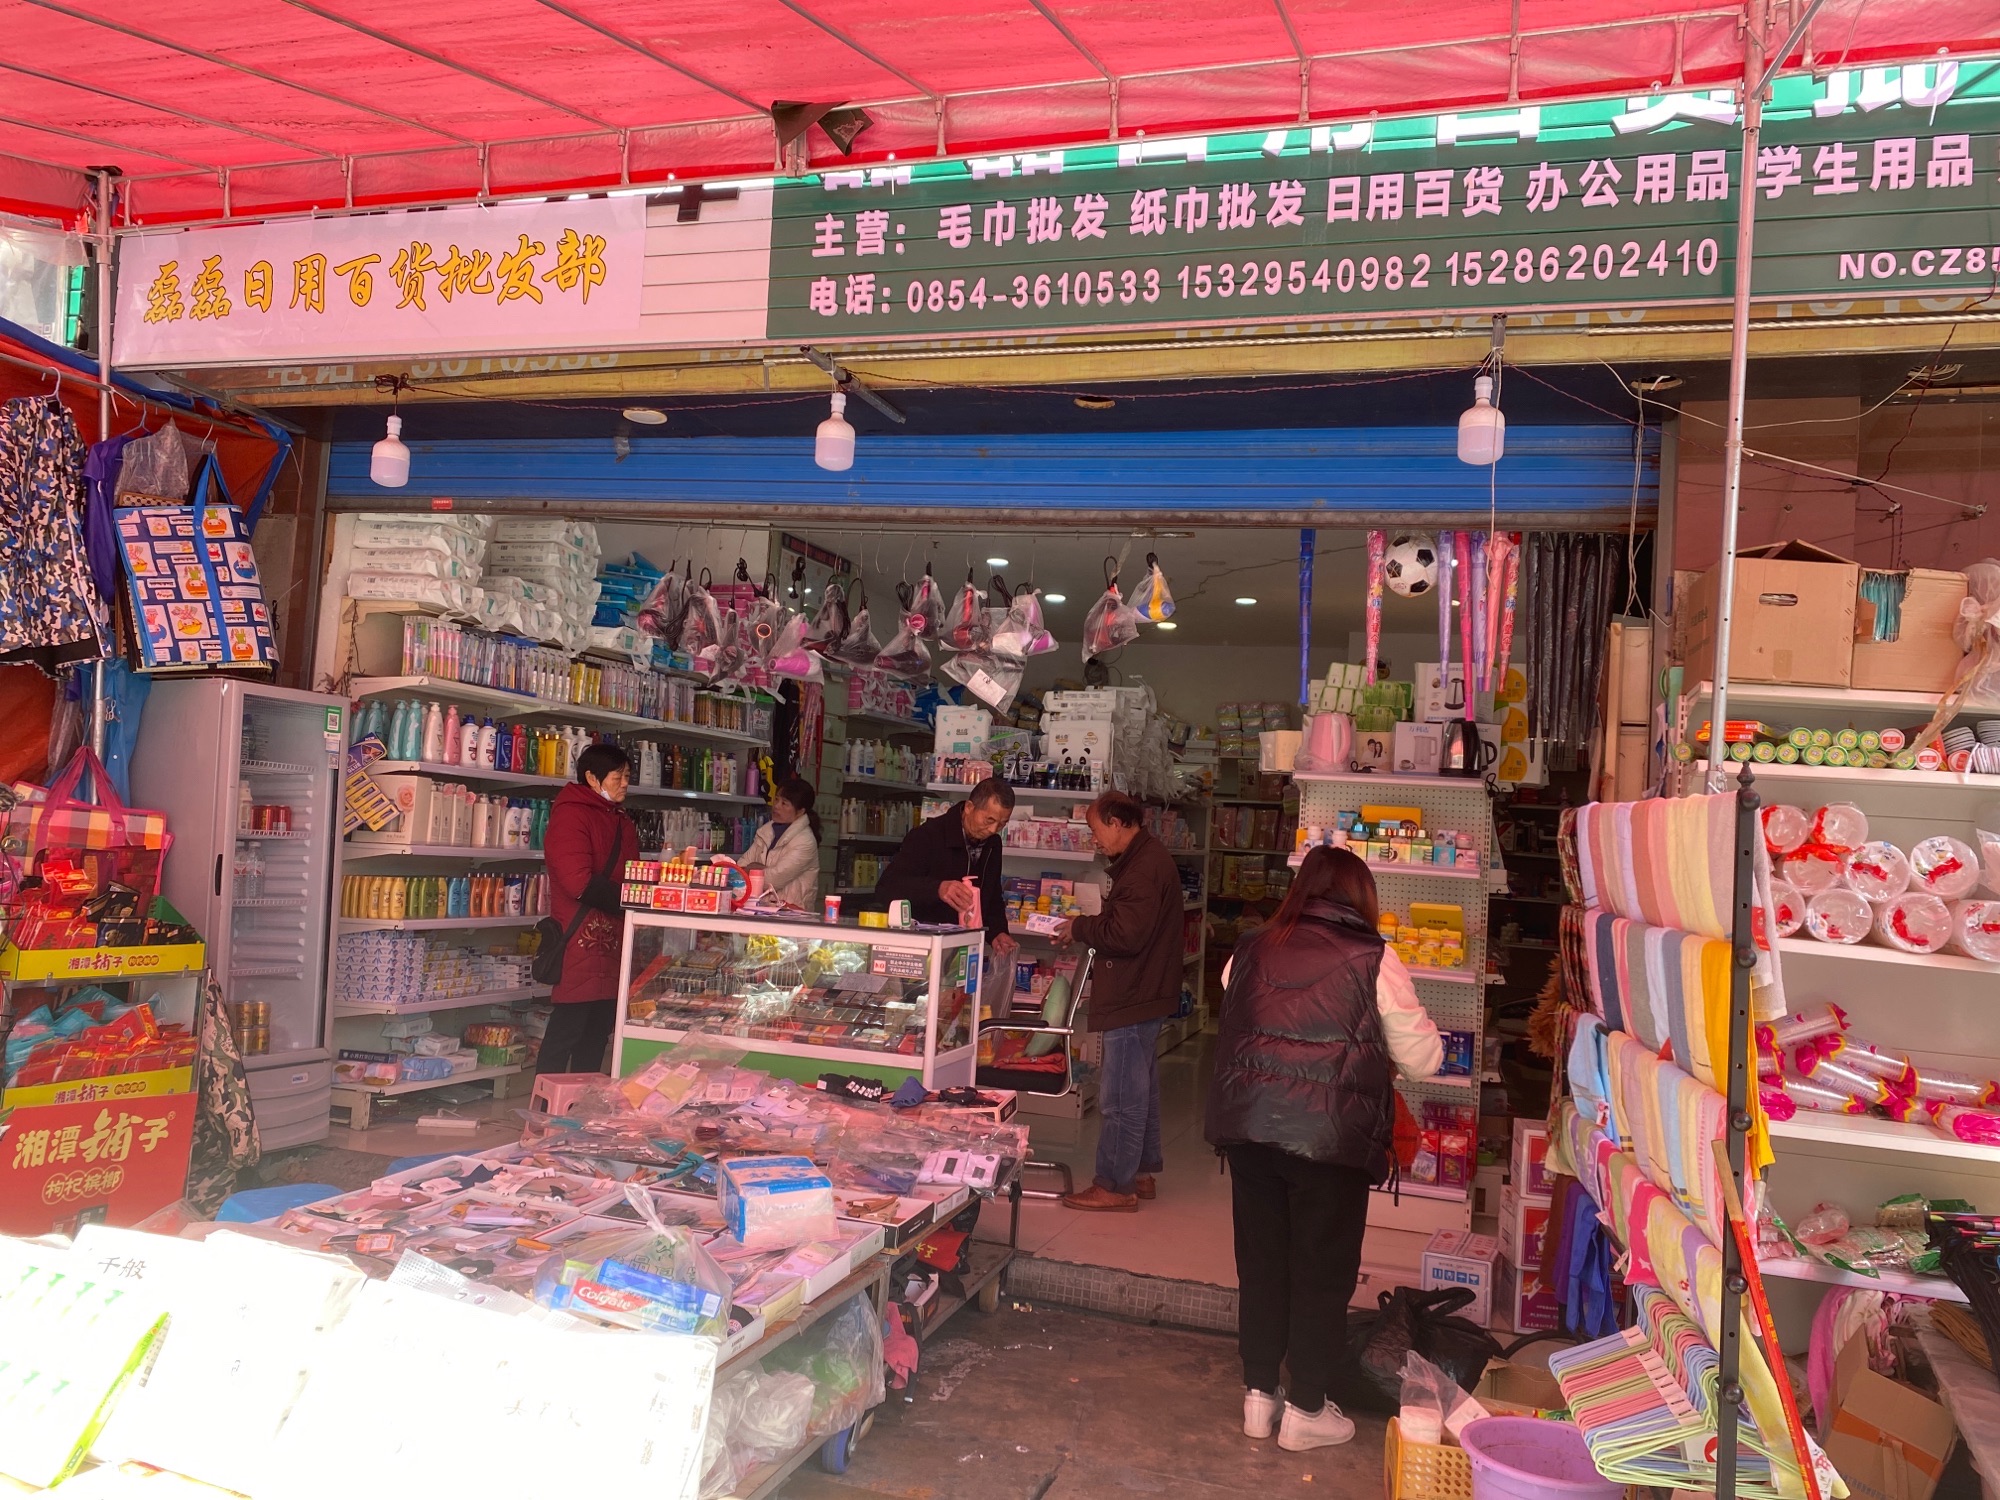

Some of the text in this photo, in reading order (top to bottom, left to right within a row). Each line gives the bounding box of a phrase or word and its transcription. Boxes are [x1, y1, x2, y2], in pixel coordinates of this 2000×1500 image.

[936, 192, 1109, 250] 毛巾批发
[1130, 180, 1307, 237] 纸巾批发
[1326, 166, 1505, 224] 日用百货
[1526, 150, 1730, 213] 办公用品
[1755, 134, 1975, 201] 学生用品
[143, 227, 608, 325] 磊磊日用百货批发部
[907, 266, 1162, 315] 0854-3610533
[1176, 251, 1430, 301] 15329540982
[1445, 237, 1720, 288] 15286202410
[68, 952, 123, 971] 湘潭铺子
[54, 1083, 109, 1105] 湘潭铺子
[12, 1108, 170, 1170] 湘潭铺子
[45, 1169, 122, 1200] 枸杞槟榔
[577, 1285, 632, 1311] Colgate
